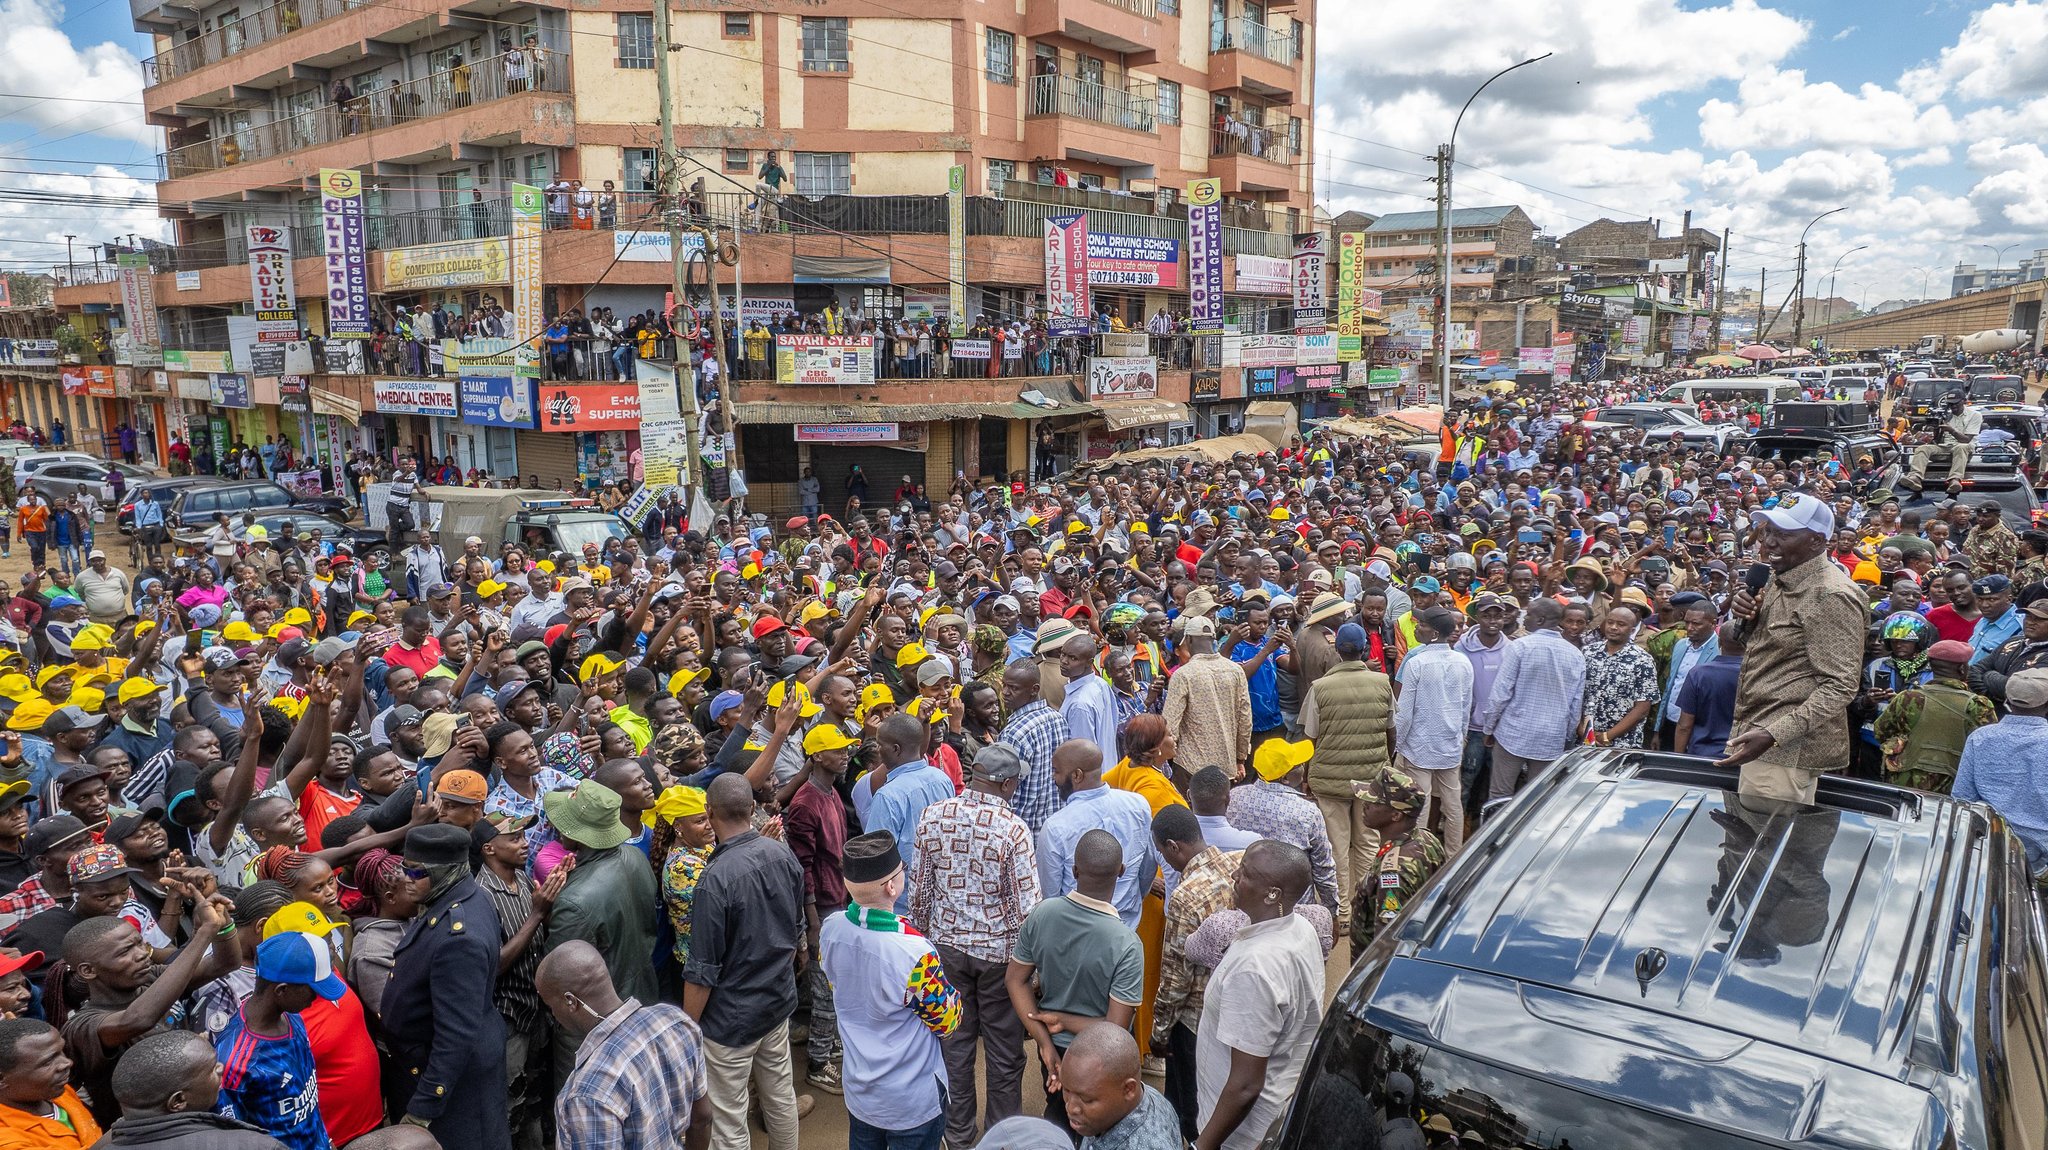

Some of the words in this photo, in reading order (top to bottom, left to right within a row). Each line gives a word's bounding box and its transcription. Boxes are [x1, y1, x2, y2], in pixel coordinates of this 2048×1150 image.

[1055, 217, 1075, 225] STOP
[345, 199, 361, 263] DRIVING
[1207, 205, 1220, 264] DRIVING
[1073, 222, 1083, 269] SCHOOL
[1109, 236, 1142, 248] DRIVING
[1143, 239, 1174, 251] SCHOOL
[324, 199, 349, 320] CLIFTON
[529, 226, 541, 288] DRIVING
[1087, 246, 1132, 259] COMPUTER
[1133, 249, 1167, 261] STUDIES
[405, 262, 446, 276] COMPUTER
[447, 259, 482, 272] COLLEGE
[1102, 260, 1115, 270] key
[1115, 261, 1121, 269] to
[1123, 262, 1136, 270] safe
[1190, 208, 1206, 318] CLIFTON
[1354, 240, 1363, 286] SCHOOL
[412, 275, 448, 288] DRIVING
[449, 272, 486, 284] SCHOOL
[516, 216, 526, 342] GREENLIGHT
[1048, 225, 1062, 319] ARIZONA
[1096, 271, 1118, 283] 0710
[1120, 272, 1136, 284] 344
[1137, 273, 1153, 284] 380
[256, 253, 274, 309] FAULU
[271, 254, 288, 309] DRIVING
[1298, 259, 1309, 308] FAULU
[1311, 258, 1320, 307] DRIVING
[1340, 249, 1354, 319] SONY
[138, 274, 152, 309] DRIVING
[351, 267, 365, 321] SCHOOL
[1074, 273, 1084, 317] DRIVING
[1210, 268, 1221, 318] SCHOOL
[1563, 292, 1601, 304] Styles
[123, 268, 143, 344] GREENLIGHT
[743, 300, 793, 309] ARIZONA
[1352, 288, 1361, 335] DRIVING
[258, 311, 294, 320] COLLEGE
[1296, 309, 1324, 317] COLLEGE
[144, 310, 158, 342] SCHOOL
[462, 339, 512, 353] CLIFTON
[780, 336, 824, 345] SAYARI
[1305, 336, 1330, 347] SONY
[1005, 348, 1021, 356] CYBER
[459, 356, 490, 366] COMPUTER
[490, 356, 515, 366] COLLEGE
[1295, 366, 1314, 377] SALON
[1320, 365, 1342, 375] BEAUTY
[388, 382, 418, 390] AFYACROSS
[419, 382, 437, 390] FAMILY
[462, 381, 488, 393] E-MART
[1261, 382, 1274, 392] SPA
[381, 392, 418, 405] MEDICAL
[419, 392, 452, 406] CENTRE
[463, 394, 500, 405] SUPERMARKET
[544, 395, 581, 414] Coca-Cola
[611, 395, 641, 406] E-MA
[589, 409, 642, 419] SUPERM
[1120, 417, 1138, 426] STEAK
[655, 419, 685, 427] GRAPHICS
[335, 466, 344, 496] DAWA
[632, 497, 654, 522] COMPUTER
